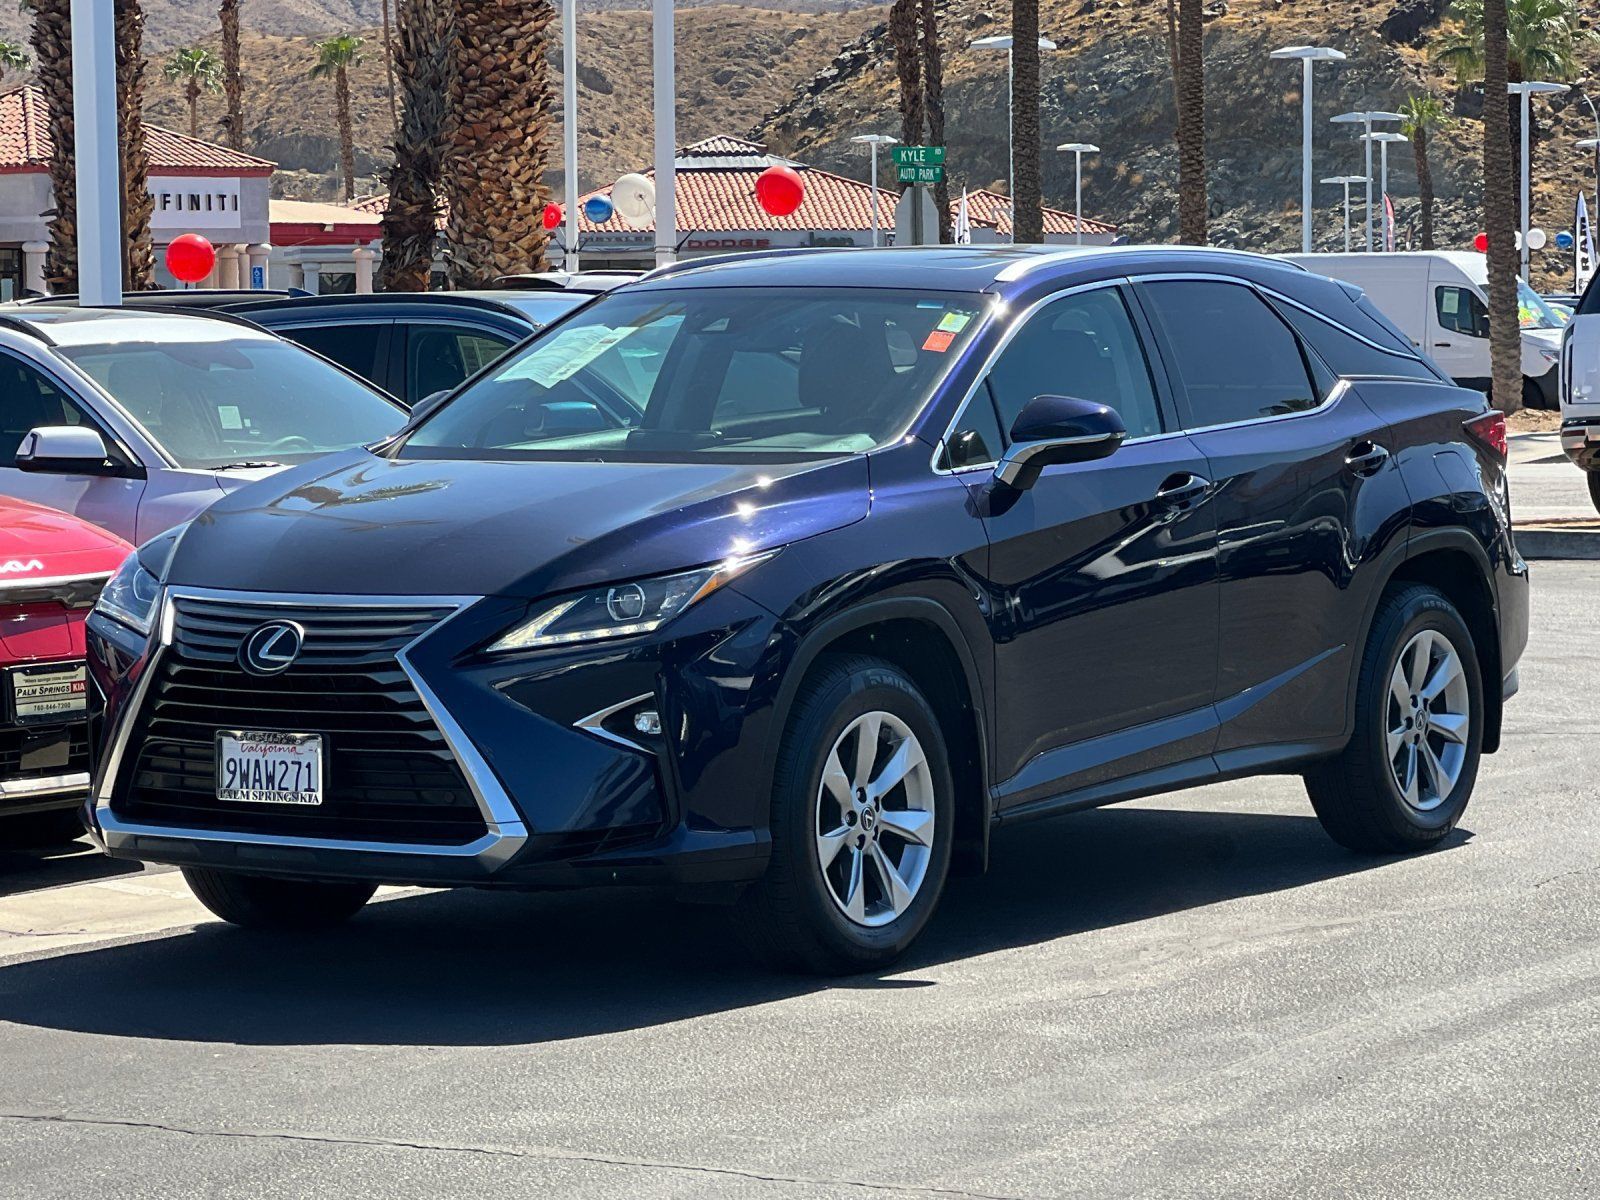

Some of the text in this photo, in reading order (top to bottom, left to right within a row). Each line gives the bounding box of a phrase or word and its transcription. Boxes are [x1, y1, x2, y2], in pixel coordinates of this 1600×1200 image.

[900, 150, 926, 162] KYLE
[900, 168, 916, 180] AUTO
[918, 168, 935, 181] PARK
[147, 193, 238, 211] FINITI
[688, 239, 770, 248] DODGE
[1580, 217, 1589, 271] RAM
[17, 682, 86, 697] PALM SPRINGS KIA
[226, 758, 315, 792] 9WAW271
[220, 788, 320, 804] PALM SPRINGS KIA
